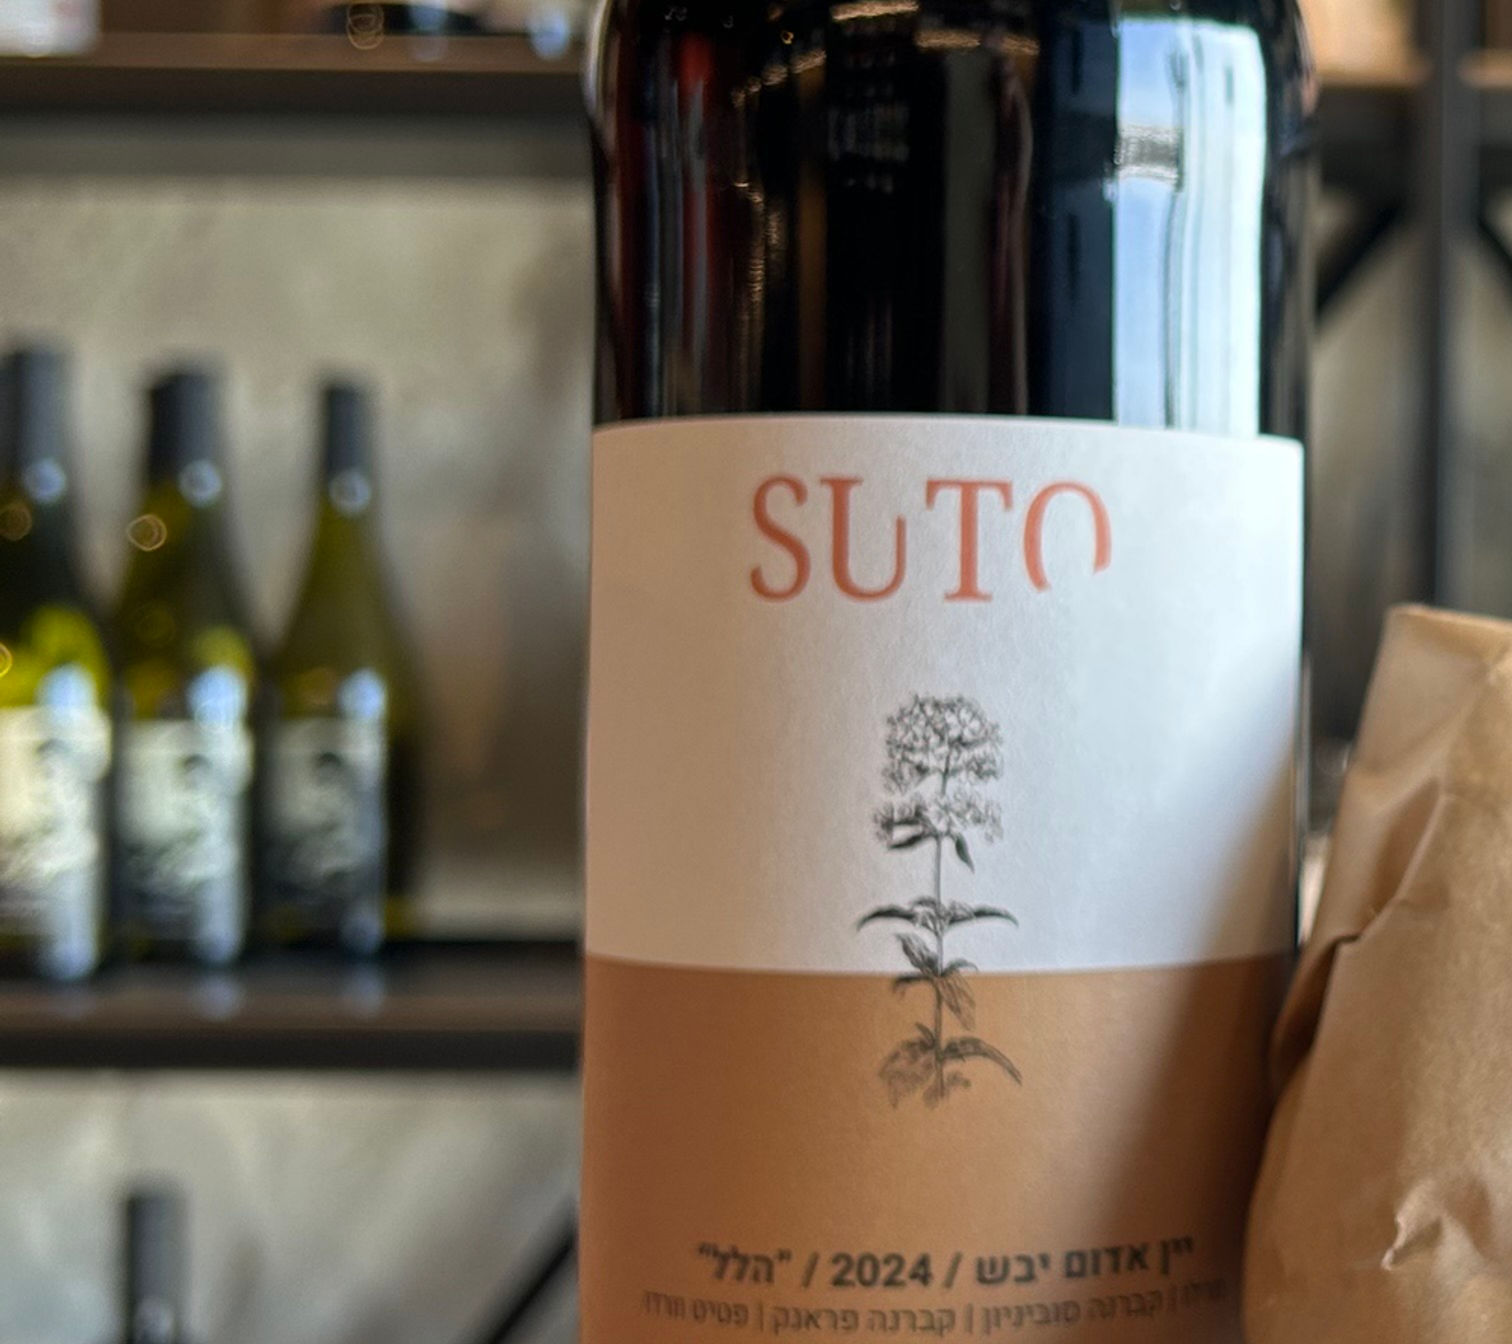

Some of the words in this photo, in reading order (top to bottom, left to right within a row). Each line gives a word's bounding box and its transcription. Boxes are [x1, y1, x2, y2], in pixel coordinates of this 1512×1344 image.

[749, 474, 1113, 603] SUTO
[831, 1252, 933, 1287] 2024
[975, 1252, 1051, 1285] יבש
[1063, 1241, 1149, 1279] אדום
[1159, 1235, 1194, 1275] יין
[771, 1304, 860, 1337] פראנק
[1087, 1287, 1164, 1321] קברנה
[867, 1306, 957, 1339] קברנה
